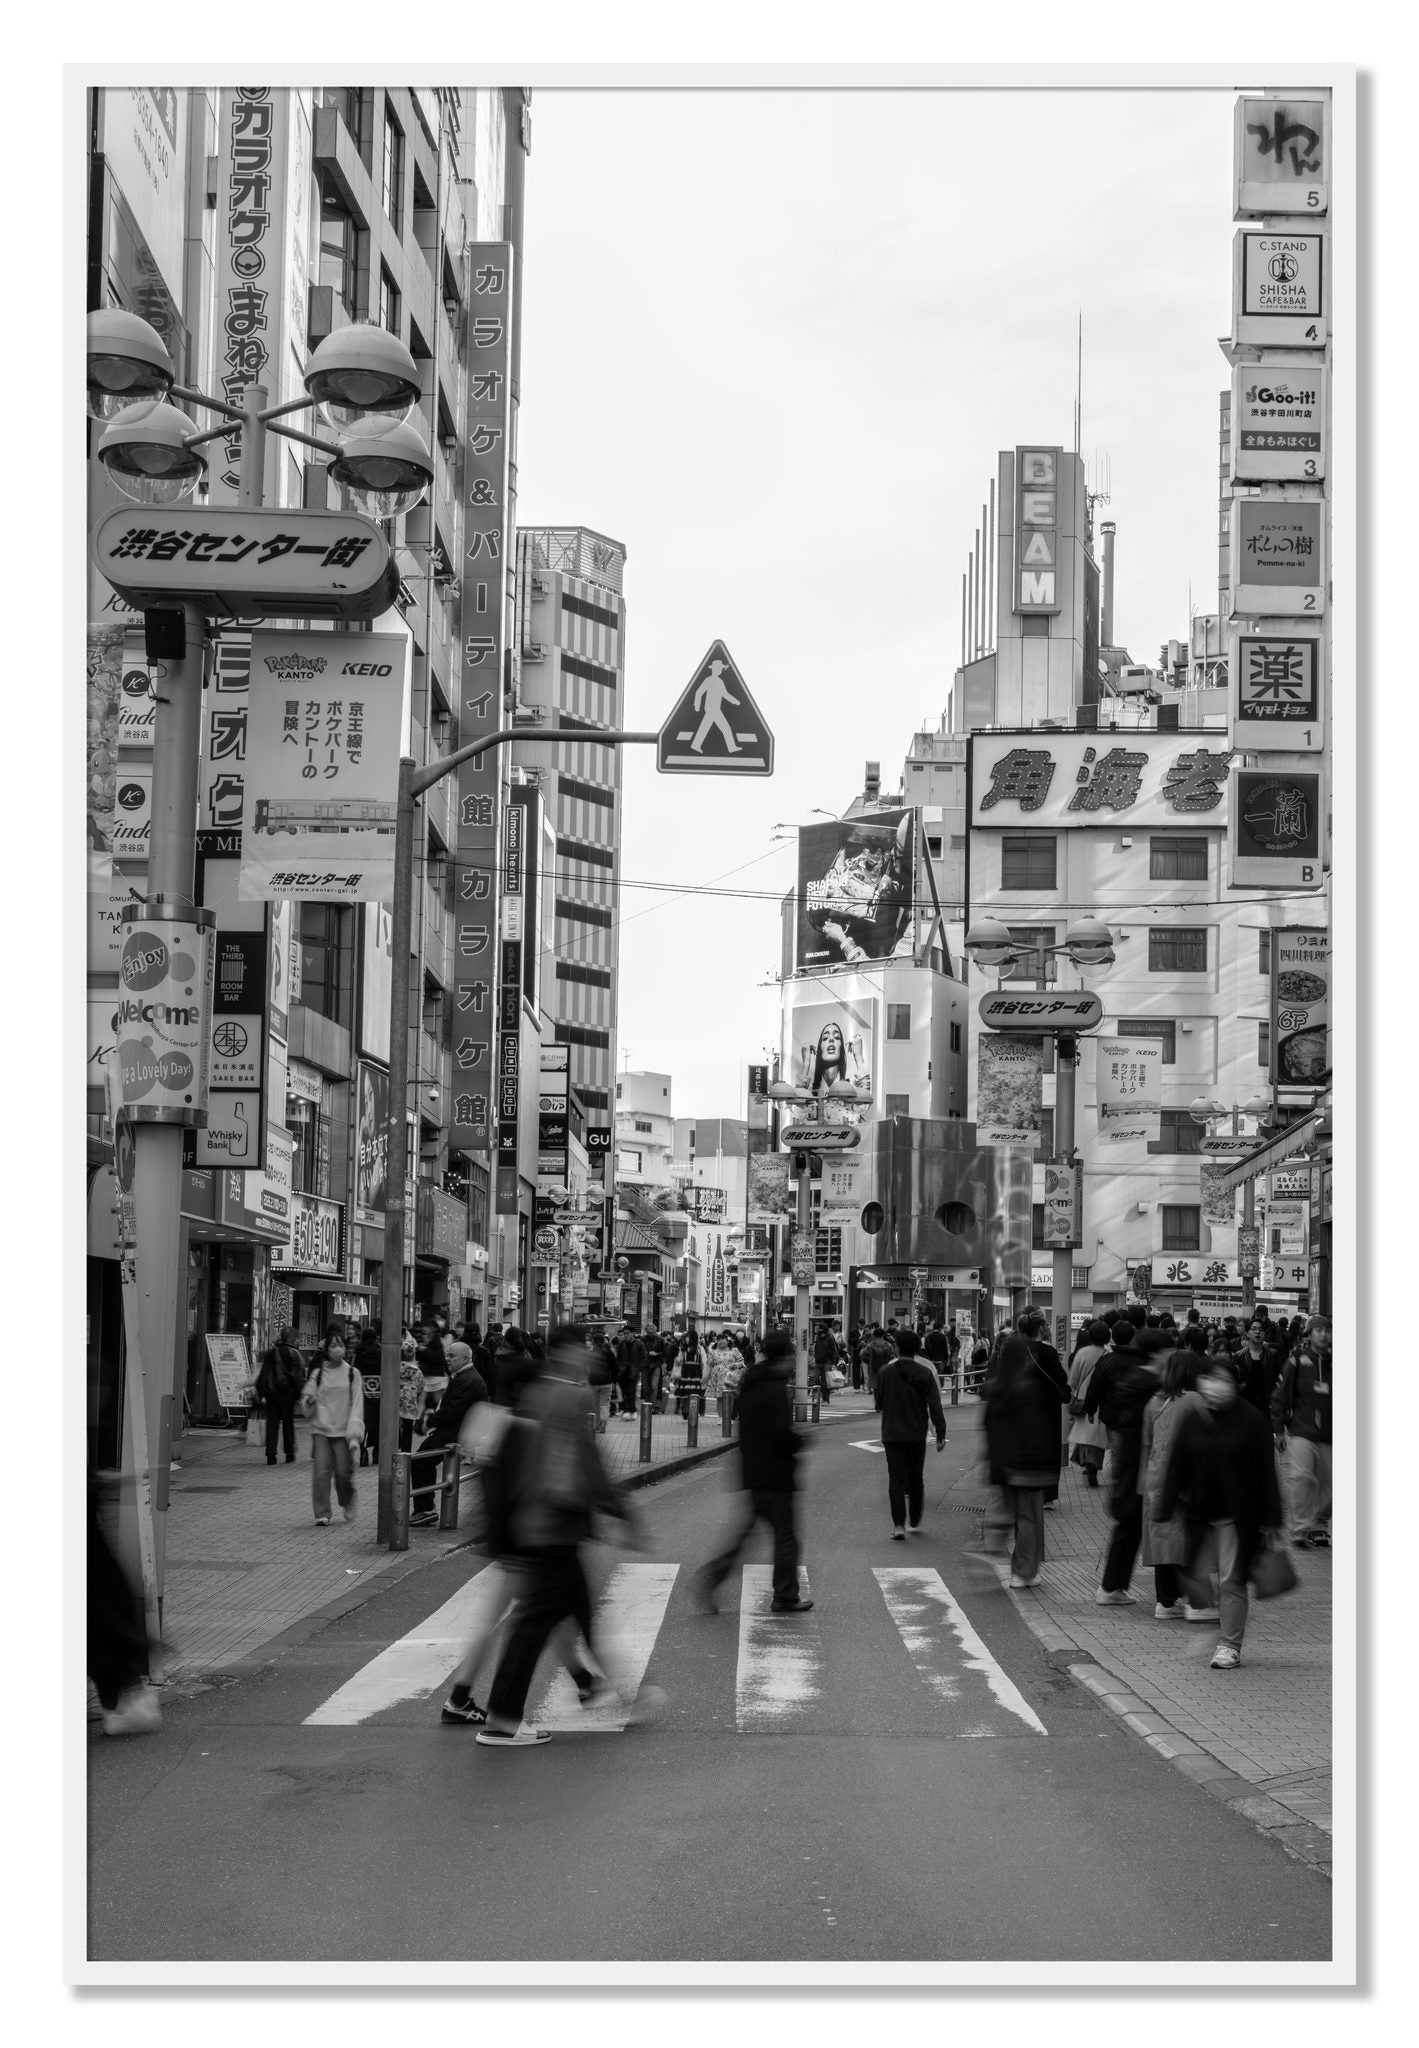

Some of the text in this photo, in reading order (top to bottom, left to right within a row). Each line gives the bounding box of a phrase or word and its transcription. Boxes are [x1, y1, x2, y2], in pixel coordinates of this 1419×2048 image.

[228, 101, 272, 248] カラオケ
[1306, 191, 1320, 207] 5
[1259, 241, 1307, 252] C.STAND
[1259, 284, 1307, 296] SHISHA
[1259, 296, 1307, 305] CAFE&BAR
[1305, 325, 1318, 341] 4
[1258, 387, 1316, 405] Goo-it!
[1250, 408, 1313, 419] 渋谷宇田川町店
[1245, 435, 1317, 448] 全身もみほぐし
[1304, 459, 1317, 477] 3
[1021, 451, 1058, 605] BEAM
[109, 528, 373, 568] 渋谷センター街
[1257, 559, 1305, 568] Pomme-no-ki
[1303, 594, 1316, 611] 2
[277, 671, 315, 680] KANTO
[340, 662, 393, 677] KEIO
[1250, 645, 1304, 699] 薬
[1244, 703, 1309, 718] マツモトキヨシ
[282, 700, 300, 746] 冒険へ
[123, 730, 149, 739] 渋谷店
[302, 700, 321, 779] カントーの
[323, 700, 343, 780] ポケパーク
[346, 701, 364, 765] 京王線で
[1303, 729, 1312, 746] 1
[119, 843, 145, 853] 渋谷店
[509, 810, 520, 890] kimono hearts
[269, 872, 363, 887] 渋谷センター街
[1302, 866, 1314, 882] B
[225, 944, 241, 952] THE
[1280, 949, 1327, 962] 四川料理
[221, 952, 245, 960] THIRD
[122, 945, 166, 983] Enjoy
[220, 982, 243, 990] ROOM
[118, 999, 200, 1026] Welcome
[986, 1001, 1096, 1015] 渋谷センター街
[1278, 1010, 1309, 1031] 6F
[137, 1060, 169, 1081] Lovely
[170, 1063, 191, 1076] Day!
[212, 1074, 234, 1082] SAKE
[1119, 1062, 1128, 1094] カントーの
[1129, 1063, 1137, 1094] ポケパーク
[207, 1130, 243, 1142] Whisky
[588, 1133, 610, 1145] GU
[784, 1131, 851, 1140] 渋谷センター街
[988, 1133, 1029, 1141] 渋谷センター街
[1108, 1129, 1147, 1140] 渋谷センター街
[207, 1140, 229, 1149] Bank
[182, 1152, 194, 1163] 1F
[1166, 1259, 1230, 1284] 兆楽
[713, 1258, 723, 1303] BEER
[711, 1305, 724, 1313] HALL
